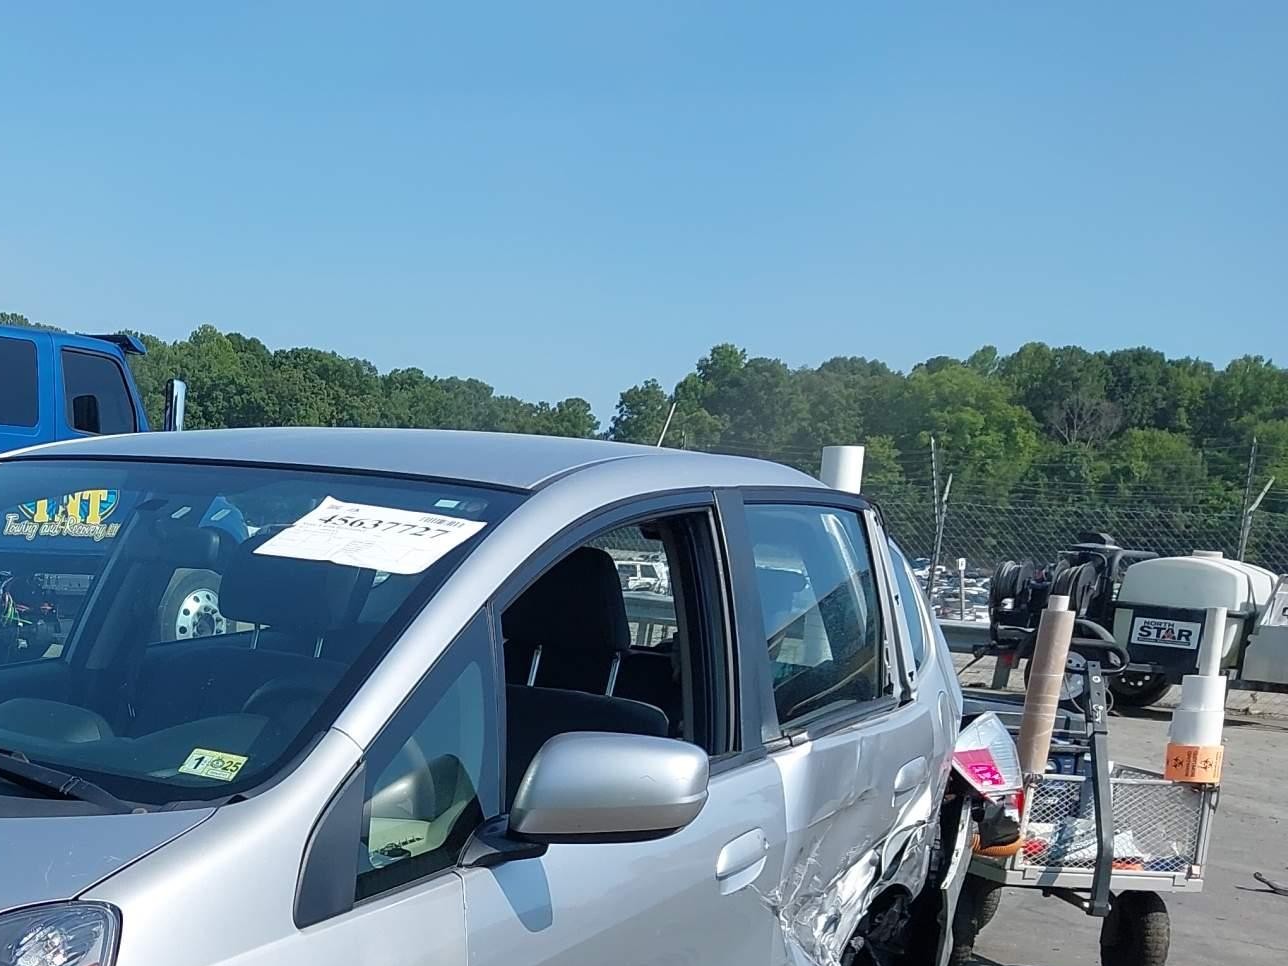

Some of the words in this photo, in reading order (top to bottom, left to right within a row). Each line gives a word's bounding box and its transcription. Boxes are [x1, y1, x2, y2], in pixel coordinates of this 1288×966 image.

[3, 513, 39, 541] Towing
[318, 514, 451, 539] 45637727
[1143, 620, 1175, 628] NORTH
[1138, 625, 1193, 642] STAR
[194, 756, 206, 769] 1
[222, 760, 242, 773] 25
